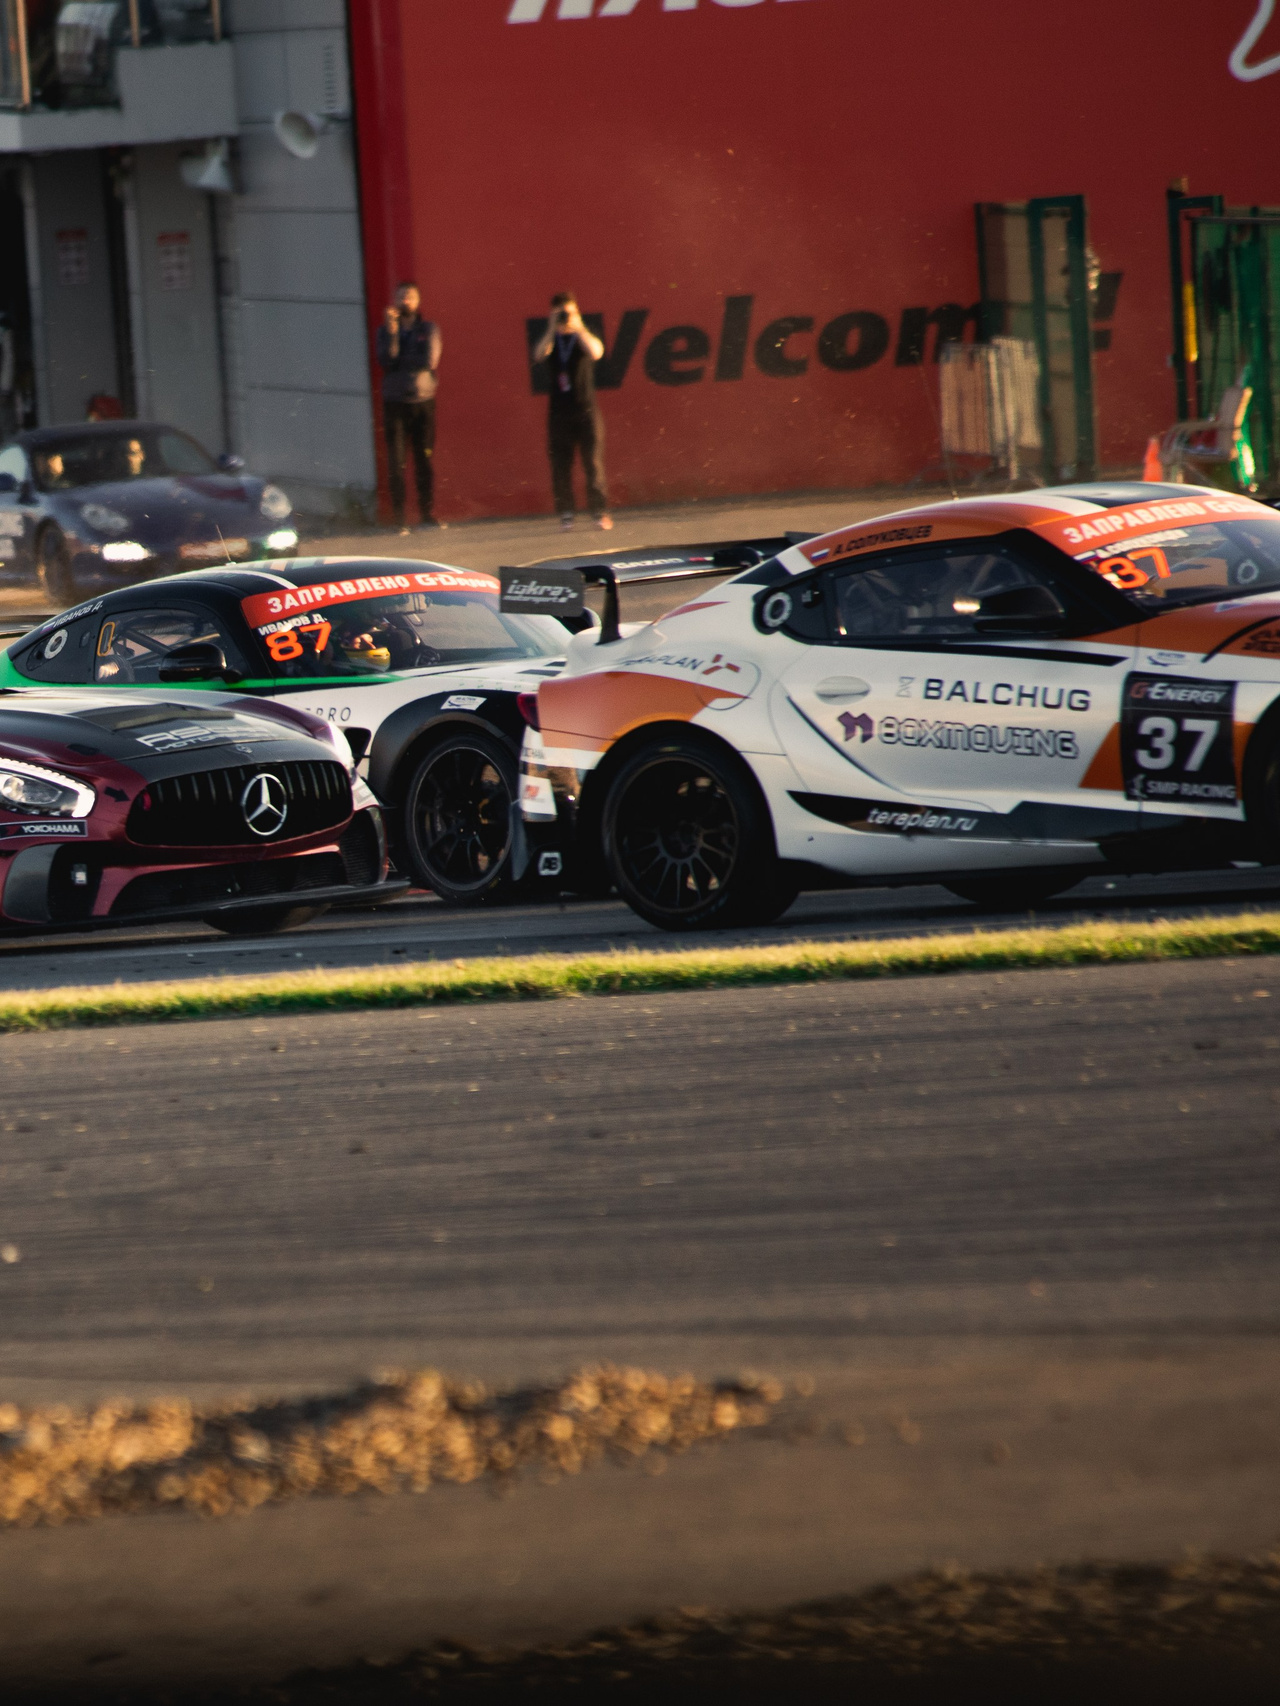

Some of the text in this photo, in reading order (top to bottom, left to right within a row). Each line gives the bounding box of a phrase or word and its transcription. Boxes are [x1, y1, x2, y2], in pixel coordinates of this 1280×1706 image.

[526, 272, 1123, 396] Welcom!
[1063, 501, 1207, 543] ЗАПРАВЛЕНО
[1098, 546, 1171, 589] 37
[267, 576, 410, 613] ЗАПРАВЛЕНО
[265, 621, 332, 662] 87
[923, 677, 1091, 712] BALCHUG
[878, 715, 1079, 760] BOXMOVING
[1135, 716, 1220, 772] 37
[22, 824, 81, 833] YOKOHAMA
[867, 808, 979, 831] teraplan.ru
